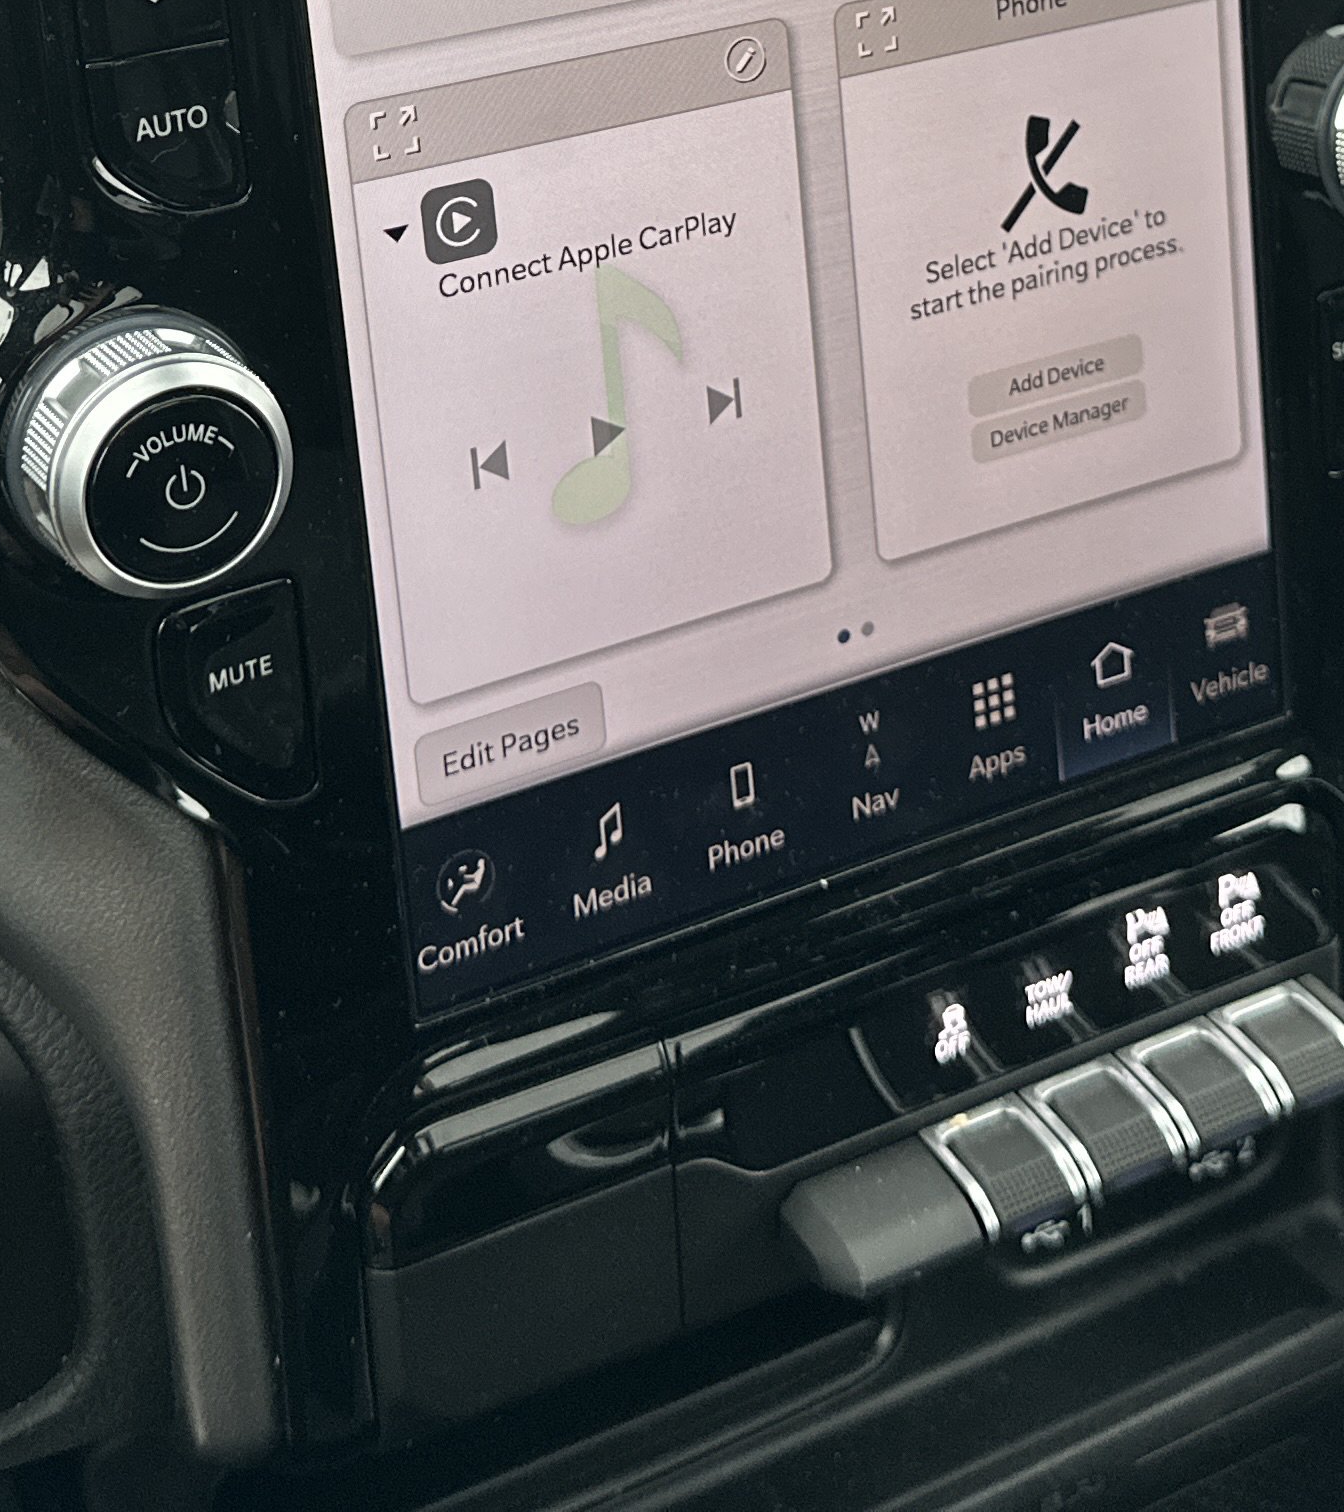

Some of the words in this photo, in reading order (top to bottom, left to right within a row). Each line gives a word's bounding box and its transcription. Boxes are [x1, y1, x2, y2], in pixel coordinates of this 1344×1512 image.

[136, 104, 209, 142] AUTO
[438, 253, 553, 298] Connect
[558, 233, 633, 272] Apple
[639, 211, 737, 251] CarPlay
[925, 249, 997, 284] Select
[1002, 232, 1053, 266] 'Add
[1058, 208, 1140, 251] Device'
[1144, 207, 1166, 229] to
[909, 292, 963, 320] start
[967, 278, 1006, 308] the
[1010, 259, 1089, 301] pairing
[1094, 238, 1185, 277] process.
[1008, 370, 1044, 396] Add
[1046, 354, 1105, 386] Device
[990, 414, 1049, 449] Device
[1052, 394, 1129, 431] Manager
[134, 424, 218, 463] VOLUME
[209, 654, 274, 693] MUTE
[1190, 660, 1271, 704] Vehicle
[1082, 702, 1150, 743] Home
[442, 740, 495, 777] Edit
[500, 716, 580, 759] Pages
[968, 743, 1027, 784] Apps
[851, 787, 900, 822] Nav
[708, 826, 786, 872] Phone
[572, 871, 654, 920] Media
[1220, 899, 1256, 927] OFF
[417, 916, 527, 973] Comfort
[1128, 934, 1165, 963] OFF
[934, 1032, 971, 1066] OFF
